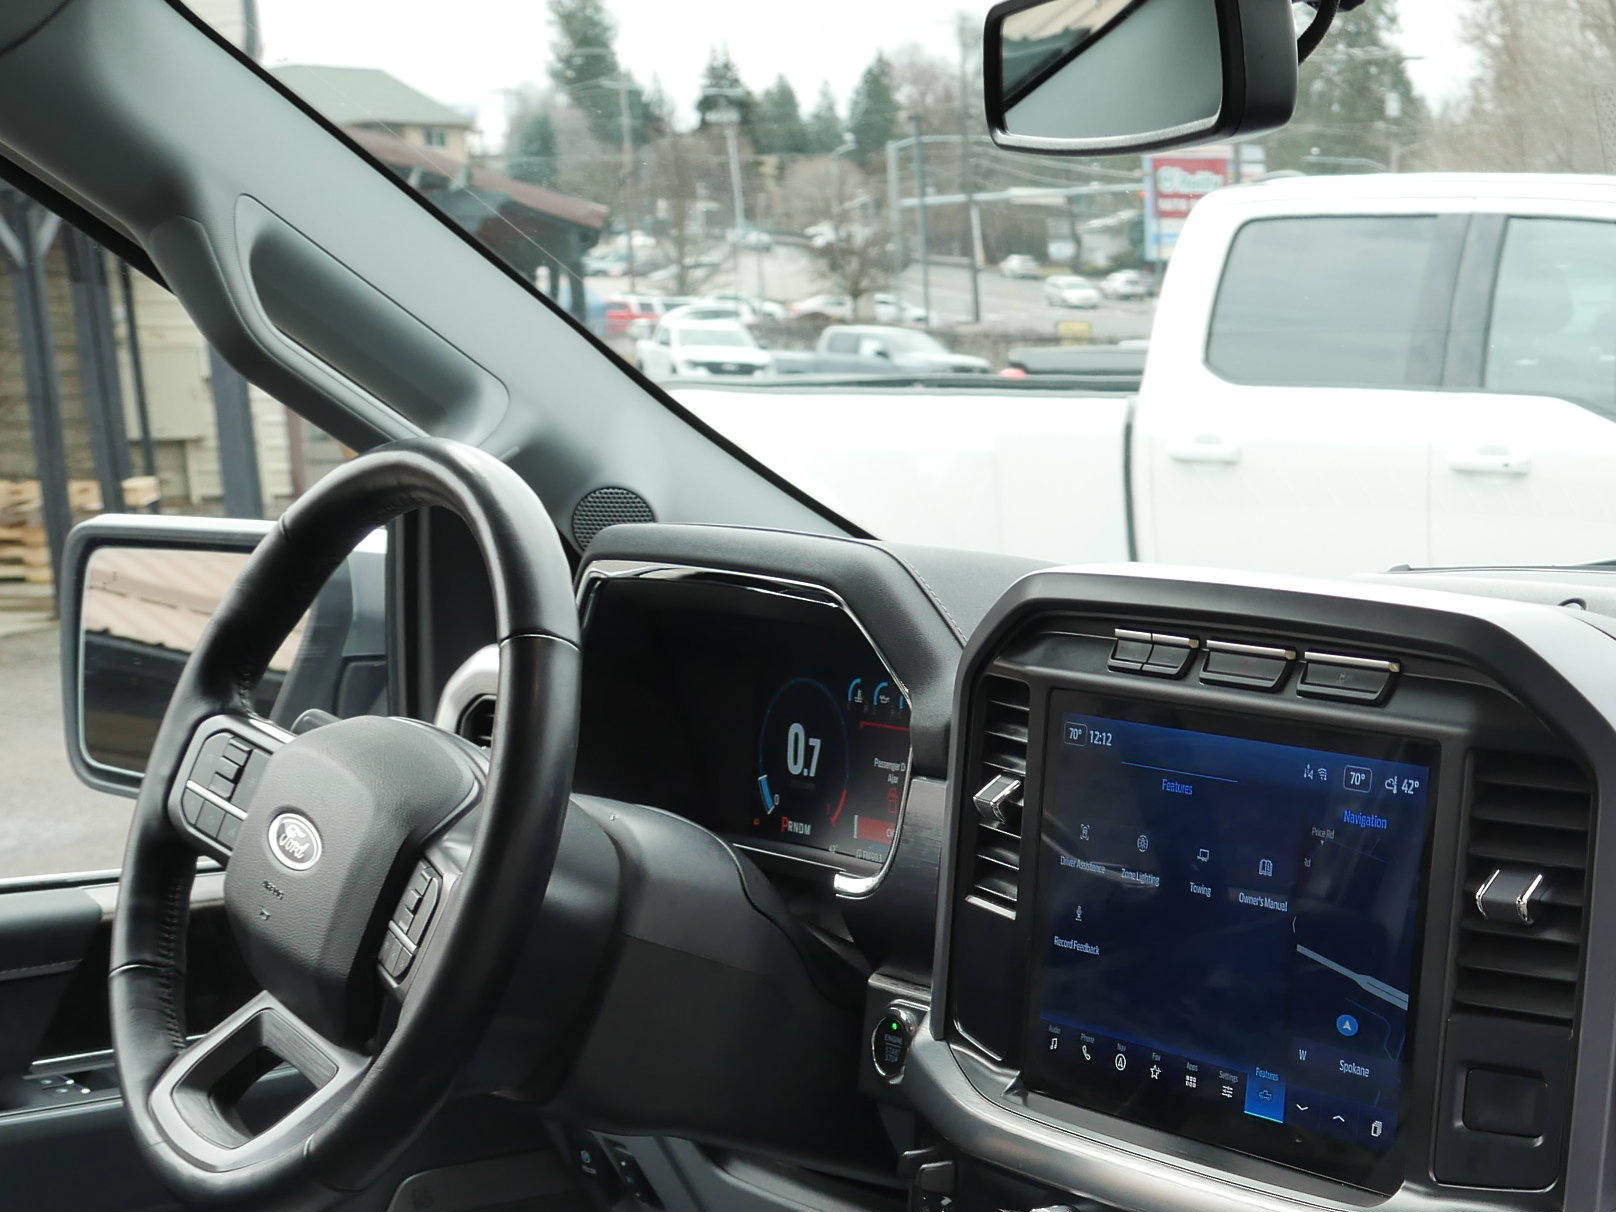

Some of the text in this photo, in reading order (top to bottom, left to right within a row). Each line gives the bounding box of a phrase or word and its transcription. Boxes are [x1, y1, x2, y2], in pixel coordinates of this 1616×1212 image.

[1069, 727, 1112, 746] 70° 12:12
[787, 722, 821, 777] 0.7
[1161, 778, 1193, 795] Features
[1350, 772, 1366, 786] 70°
[1401, 779, 1420, 794] 42°
[1343, 810, 1387, 829] Navigation
[1060, 856, 1076, 868] Driver
[1121, 868, 1159, 887] Zone Lighting
[1189, 882, 1211, 898] Towing
[1239, 892, 1288, 911] Owner's Manual
[1054, 936, 1100, 955] Record Feedback
[1048, 1024, 1061, 1034] Audio
[1080, 1033, 1095, 1044] Phone
[1117, 1042, 1127, 1052] Nav
[1152, 1052, 1161, 1062] Fav
[1186, 1062, 1198, 1072] Apps
[1255, 1067, 1279, 1082] Features
[1339, 1059, 1370, 1078] Spokane
[1218, 1070, 1239, 1084] Settings
